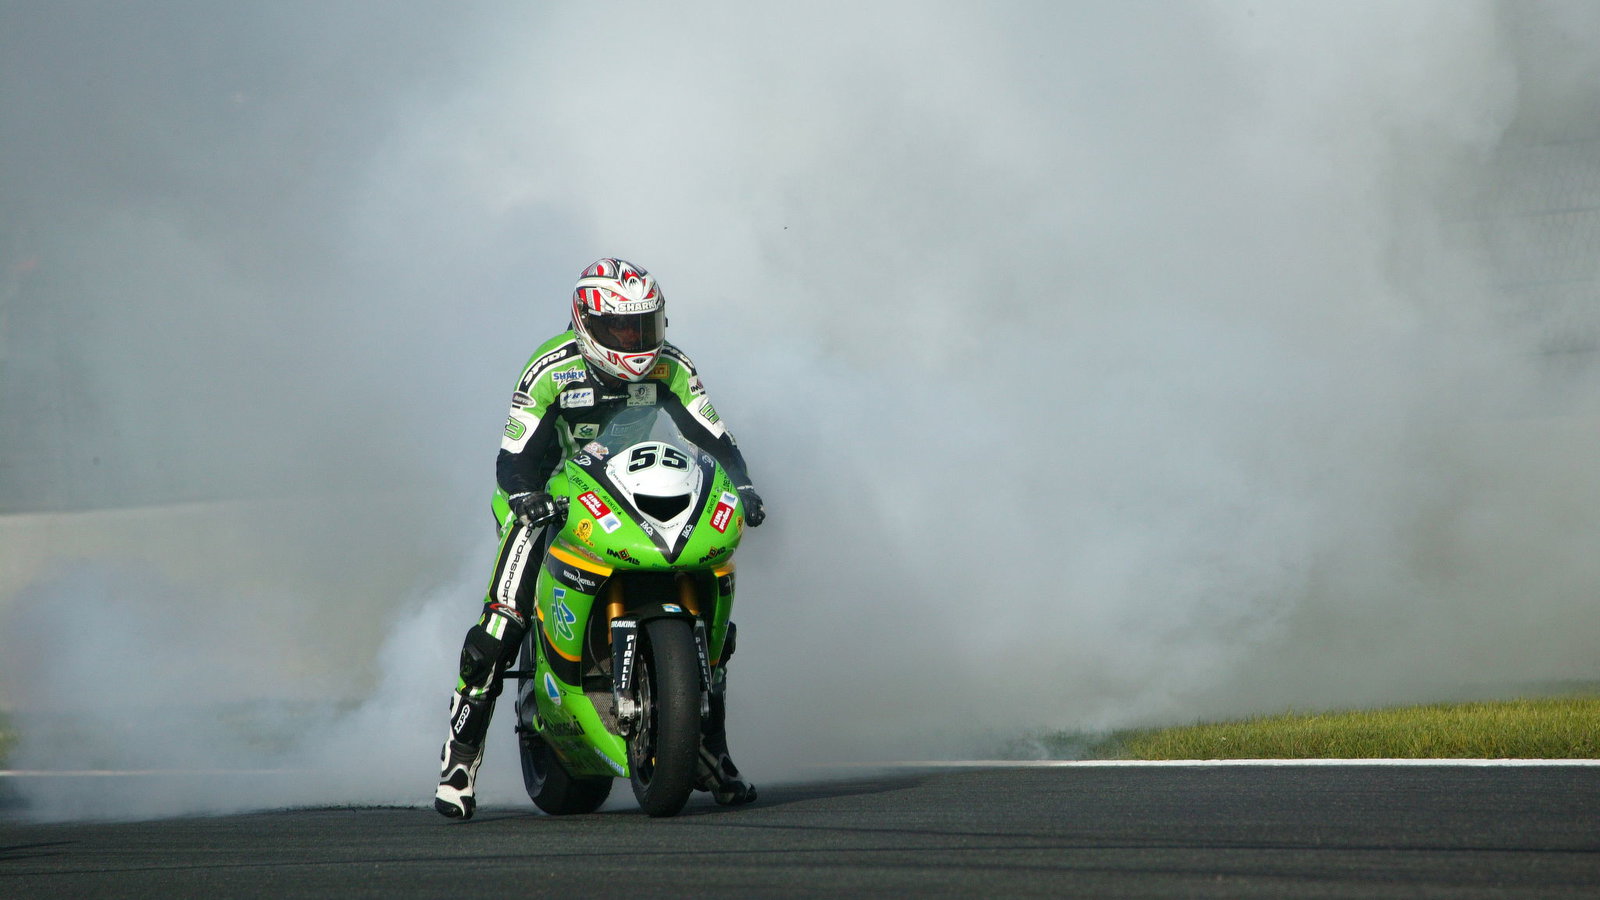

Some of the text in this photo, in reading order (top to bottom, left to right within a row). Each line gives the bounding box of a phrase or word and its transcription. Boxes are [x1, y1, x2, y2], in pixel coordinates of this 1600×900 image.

[618, 301, 656, 312] SHARK
[553, 370, 585, 382] SHARK
[628, 446, 688, 472] 55
[502, 526, 533, 605] OTORSPORT
[611, 620, 637, 628] BRAKING
[621, 634, 636, 690] PIRELLI
[695, 636, 710, 691] PIRELLI
